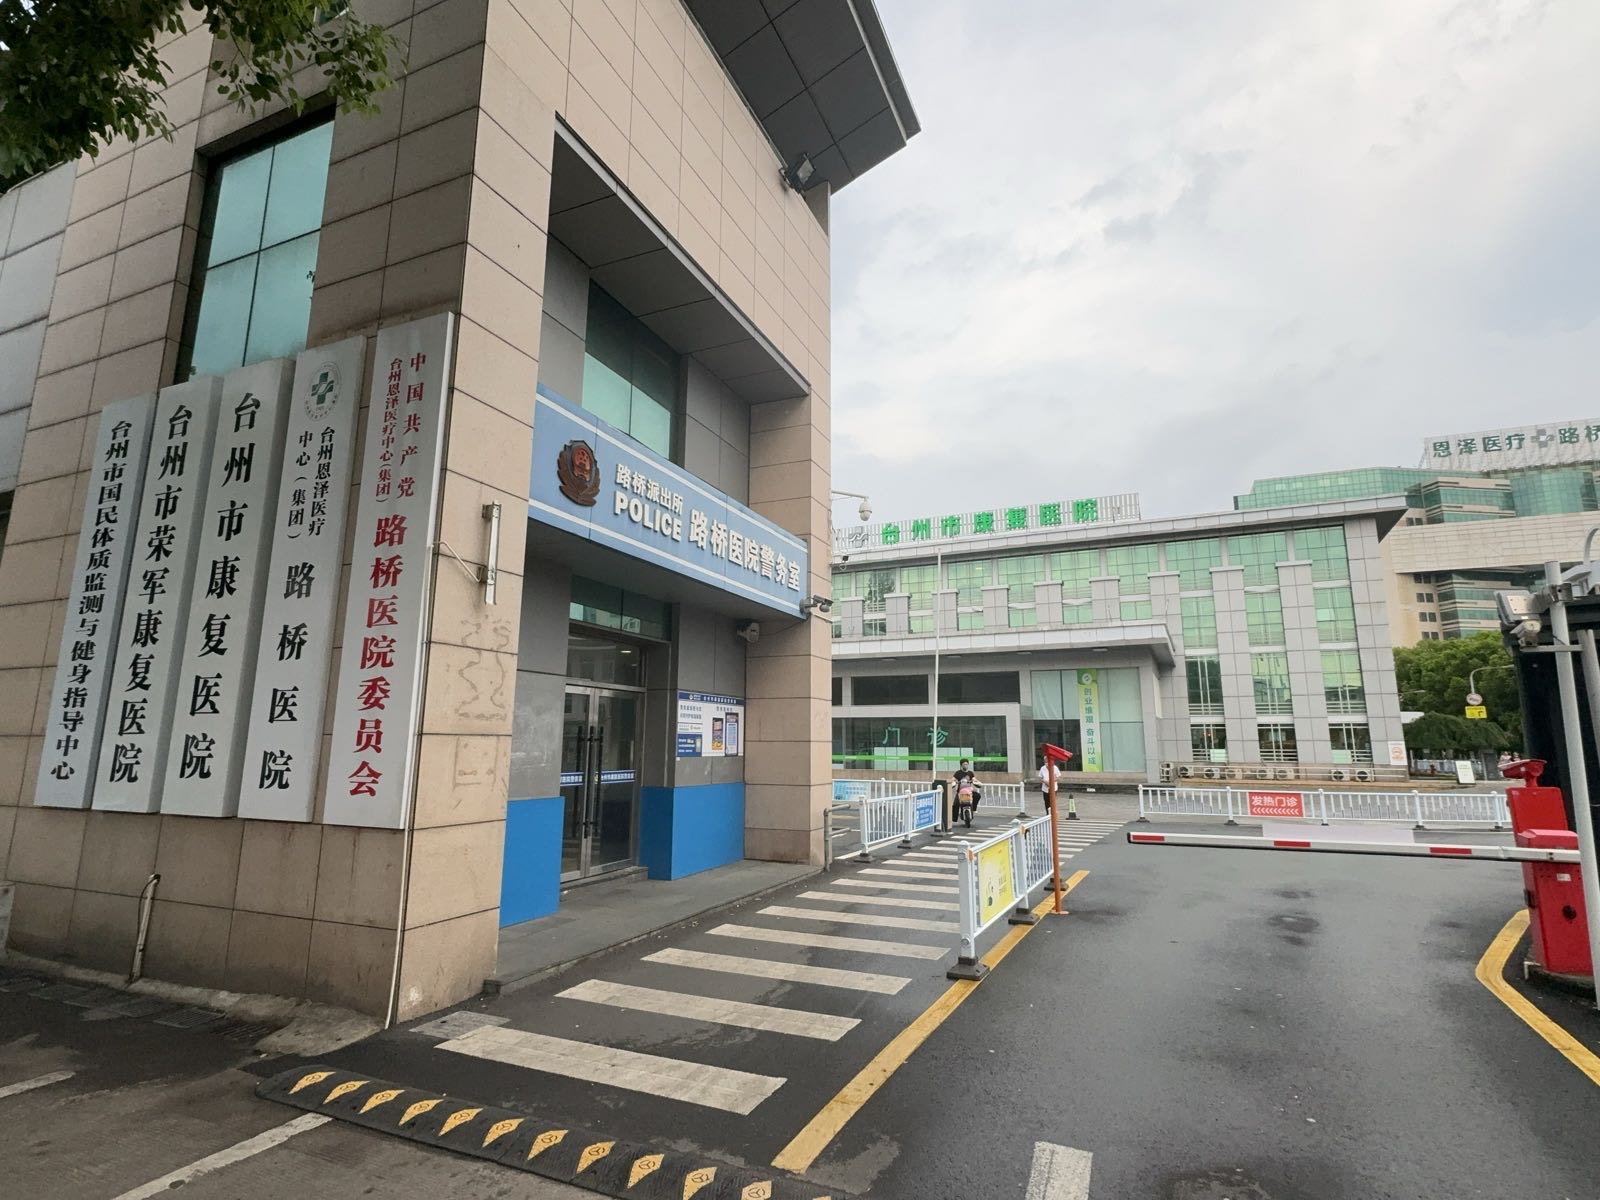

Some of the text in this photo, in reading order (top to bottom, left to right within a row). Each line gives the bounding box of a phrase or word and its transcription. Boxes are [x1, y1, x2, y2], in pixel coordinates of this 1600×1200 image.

[397, 352, 426, 498] 中国共产党
[1432, 433, 1525, 458] 恩泽医疗
[308, 426, 335, 536] 台州恩泽医疗
[614, 490, 683, 542] POLICE
[616, 463, 684, 516] 路桥派出所
[50, 420, 133, 781] 台州市国民体质监测与健身指导中心
[109, 404, 193, 784] 台州市荣军康复医院
[179, 392, 261, 781] 台州市康复医院
[689, 508, 801, 592] 路桥医院警务室
[258, 561, 316, 790] 路桥医院
[348, 513, 408, 797] 路桥医院委员会
[882, 726, 949, 746] 门诊
[1252, 795, 1298, 807] 发热门诊
